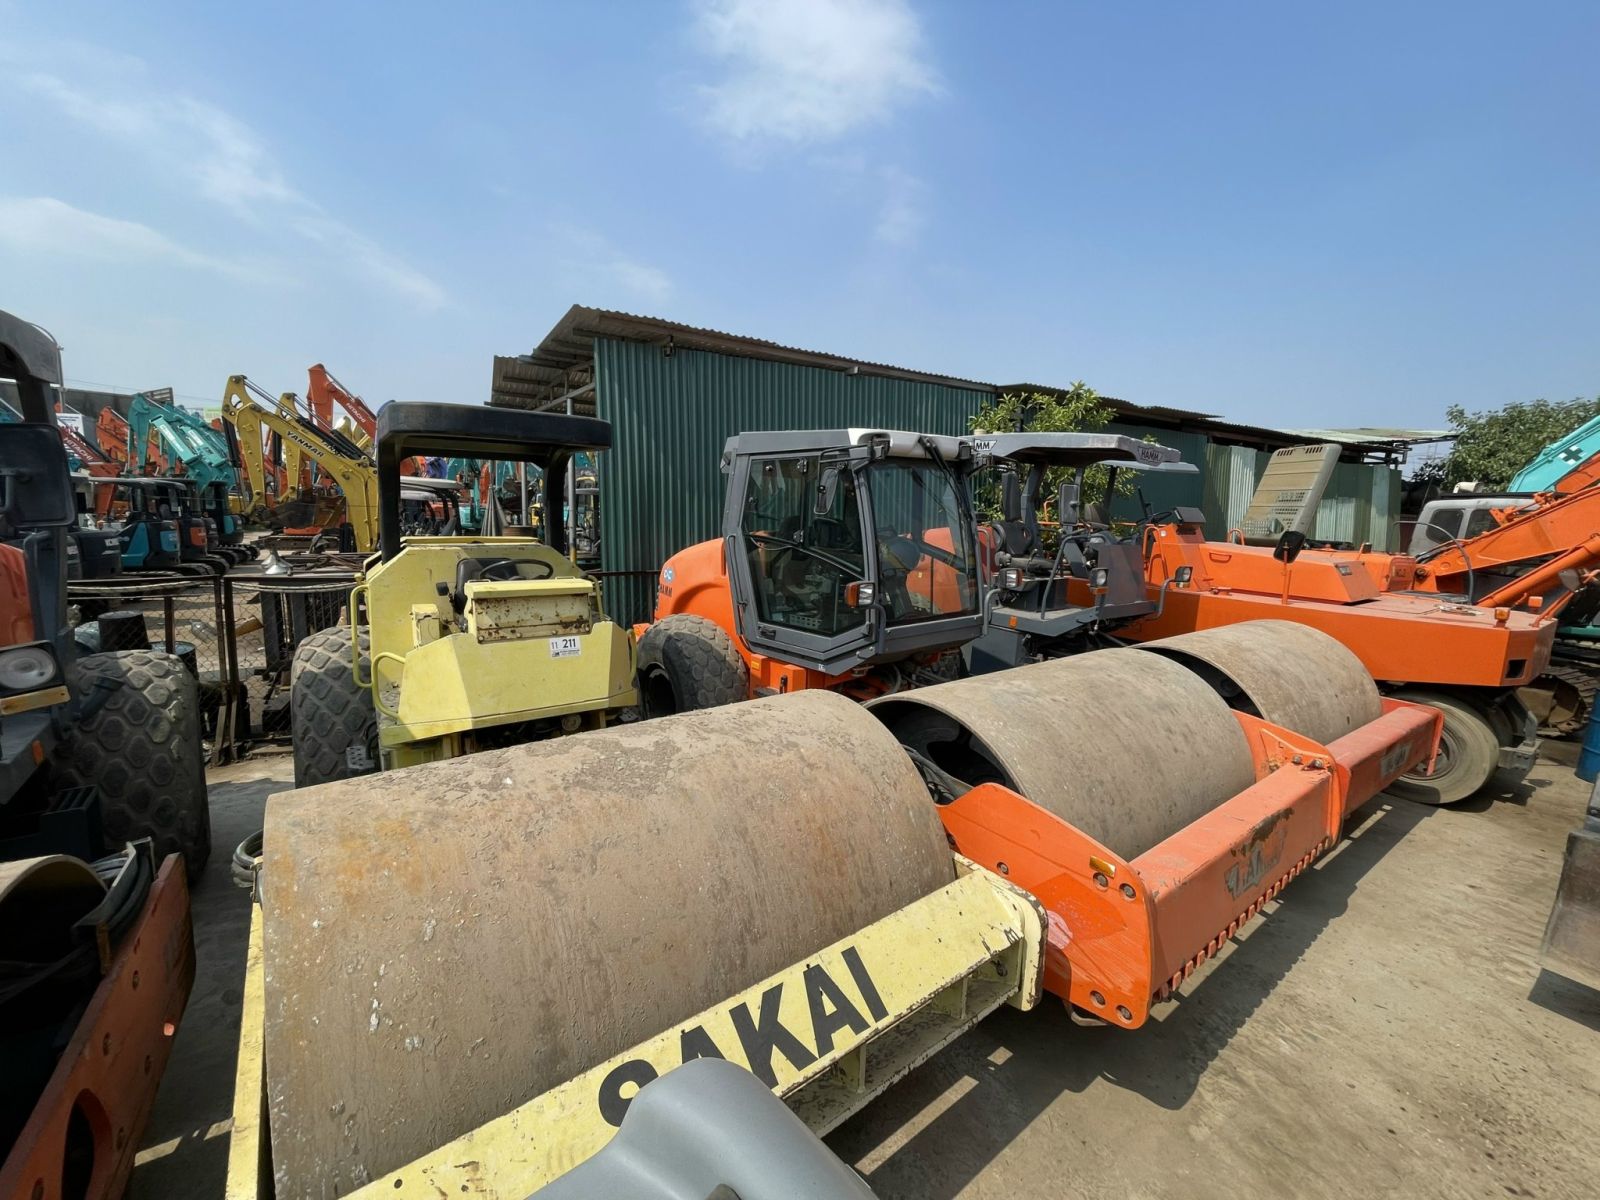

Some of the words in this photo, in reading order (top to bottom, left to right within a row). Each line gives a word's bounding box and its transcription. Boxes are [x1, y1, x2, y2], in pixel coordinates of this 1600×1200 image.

[287, 431, 325, 457] YANMAR
[976, 441, 990, 450] MM
[562, 638, 576, 648] 211
